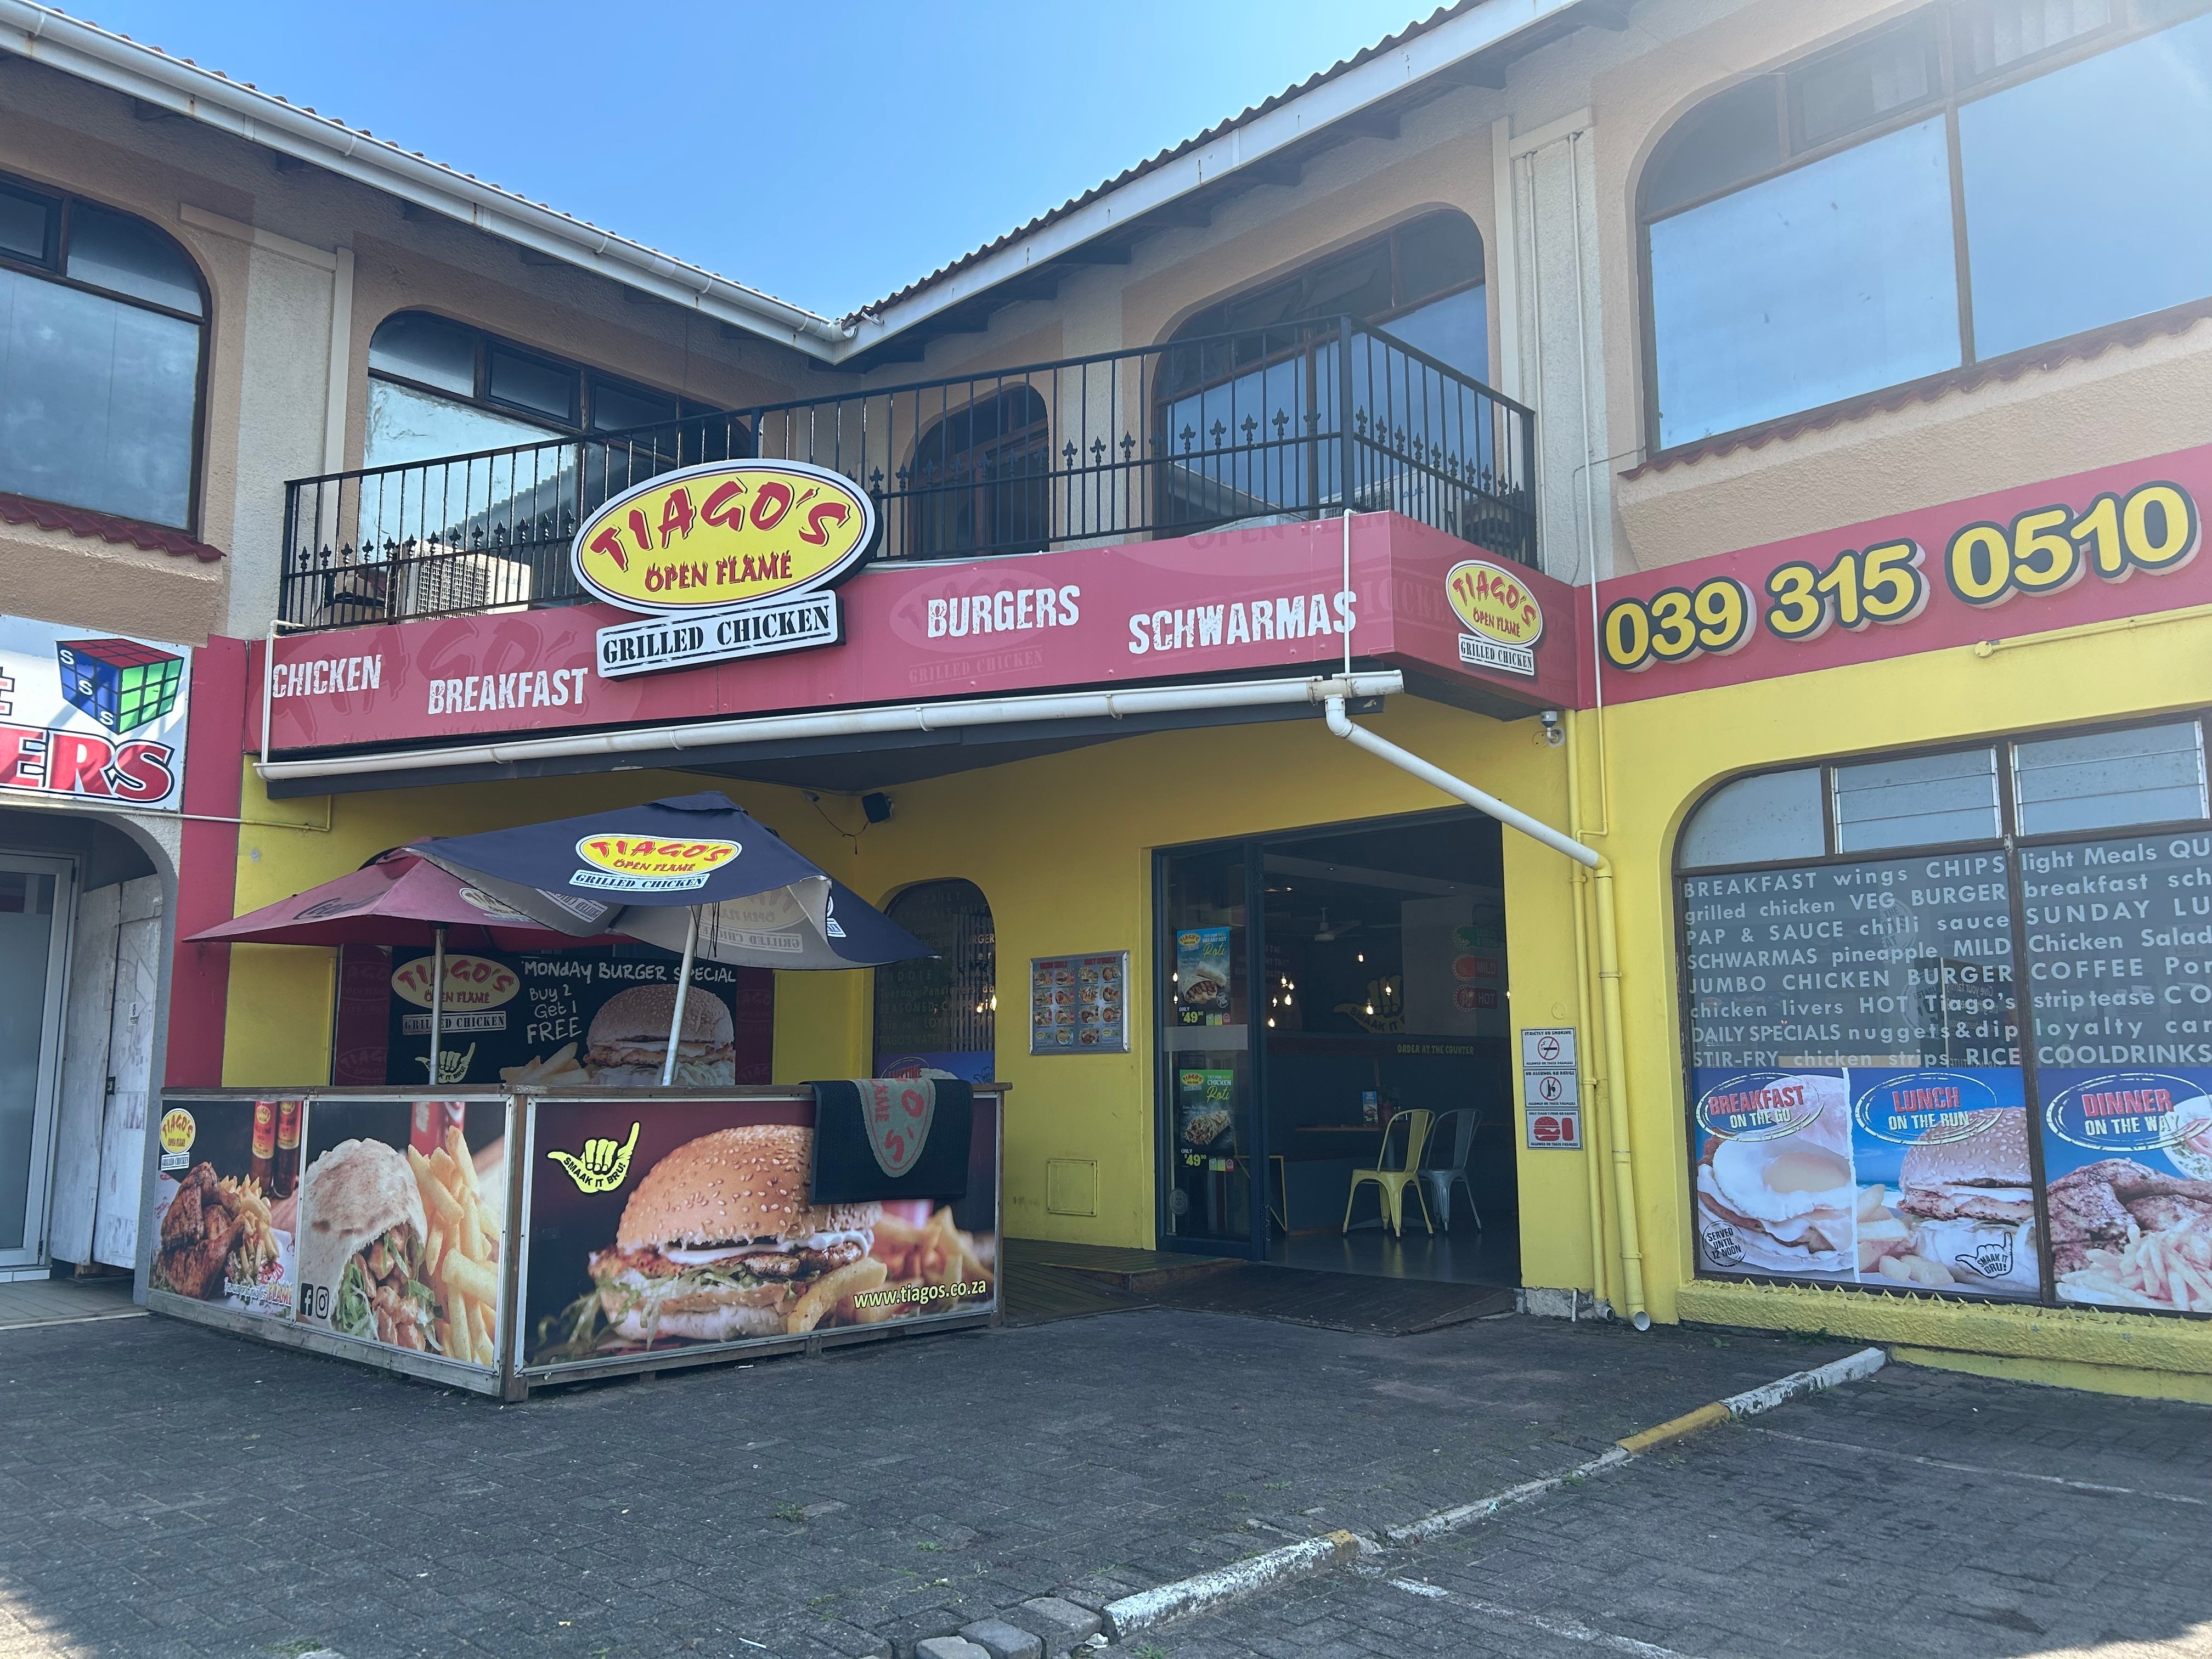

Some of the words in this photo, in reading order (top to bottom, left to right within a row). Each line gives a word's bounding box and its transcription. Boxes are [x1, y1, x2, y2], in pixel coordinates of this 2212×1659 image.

[590, 476, 851, 572] TIAGO'S
[644, 560, 709, 592] OPEN
[715, 550, 793, 585] FLAME
[1602, 577, 1748, 672] 039
[1765, 538, 1925, 641] 315
[1945, 481, 2199, 608] 0510
[1452, 569, 1536, 627] TIAGO'S
[927, 585, 1080, 637] BURGERS
[1128, 589, 1357, 655] SCHWARMAS
[1473, 606, 1494, 630] OPEN
[1496, 615, 1521, 638] FLAME
[602, 625, 704, 664] GRILLED
[716, 605, 830, 646] CHICKEN
[1460, 641, 1495, 661] GRILLED
[1498, 650, 1532, 669] CHICKEN
[272, 654, 382, 699] CHICKEN
[428, 667, 589, 715] BREAKFAST
[589, 840, 732, 862] TIAGO'S
[2022, 851, 2074, 873] light
[2084, 843, 2157, 866] Meals
[2169, 838, 2210, 859] QU
[613, 859, 651, 871] OPEN
[653, 862, 696, 872] FLAME
[1684, 872, 1818, 898] BREAKFAST
[1834, 867, 1908, 889] wings
[1926, 856, 2005, 878] CHIPS
[576, 873, 636, 888] GRILLED
[641, 876, 705, 888] CHICKEN
[2024, 873, 2148, 898] breakfast
[1684, 899, 1746, 926] grilled
[1759, 895, 1836, 917] chicken
[1849, 892, 1896, 911] VEG
[1911, 882, 2007, 907] BURGER
[2025, 900, 2150, 925] SUNDAY
[1686, 927, 1726, 946] PAP
[1741, 927, 1755, 943] &
[1769, 920, 1844, 941] SAUCE
[1859, 916, 1919, 936] chilli
[1937, 915, 2010, 932] sauce
[2029, 932, 2123, 952] Chicken
[1203, 941, 1226, 960] Roti
[1686, 947, 1818, 970] SCHWARMAS
[1832, 942, 1938, 967] pineapple
[1953, 937, 2011, 957] MILD
[598, 962, 668, 980] BURGER
[1476, 960, 1496, 975] MILD
[1689, 974, 1767, 994] JUMBO
[1782, 969, 1890, 991] CHICKEN
[1908, 964, 2013, 986] BURGER
[2031, 958, 2143, 980] COFFEE
[456, 990, 490, 1004] FLAME
[562, 984, 572, 996] 2
[1477, 992, 1495, 1005] HOT
[534, 1003, 567, 1019] Get
[1690, 1001, 1767, 1019] chicken
[1782, 999, 1843, 1016] livers
[1860, 995, 1909, 1015] HOT
[1925, 993, 2016, 1015] Tiago's
[456, 1015, 505, 1029] CHICKEN
[527, 1017, 583, 1044] FREE
[1692, 1026, 1745, 1043] DAILY
[1750, 1024, 1841, 1042] SPECIALS
[2036, 1016, 2142, 1040] loyalty
[1397, 1044, 1420, 1054] ORDER
[1421, 1045, 1431, 1053] AT
[1431, 1045, 1444, 1054] THE
[1445, 1045, 1474, 1054] COUNTER
[1693, 1051, 1779, 1068] STIR-FRY
[1793, 1049, 1872, 1067] chicken
[1888, 1048, 1950, 1068] strips
[1966, 1047, 2021, 1065] RICE
[2038, 1044, 2212, 1064] COOLDRINKS
[1206, 1085, 1231, 1103] Roti
[1708, 1085, 1804, 1116] BREAKFAST
[1892, 1087, 1961, 1113] LUNCH
[2081, 1088, 2175, 1118] DINNER
[162, 1114, 193, 1139] TIAGO'S
[1730, 1114, 1747, 1128] ON
[1749, 1110, 1772, 1126] THE
[1775, 1108, 1792, 1122] GO
[1888, 1115, 1908, 1131] ON
[1911, 1113, 1937, 1130] THE
[1940, 1110, 1971, 1127] RUN
[2084, 1119, 2108, 1136] ON
[2111, 1116, 2141, 1135] THE
[2144, 1114, 2180, 1132] WAY
[563, 1156, 593, 1186] SMAAK
[595, 1178, 604, 1188] IT
[606, 1161, 626, 1185] BRU!
[1707, 1227, 1734, 1242] SERVED
[1713, 1237, 1735, 1250] UNTIL
[1711, 1250, 1721, 1260] 12
[1720, 1244, 1742, 1257] NOON
[1977, 1253, 2001, 1268] SMAAK
[2002, 1254, 2008, 1263] IT
[853, 1279, 988, 1309] www.tiagos.co.za
